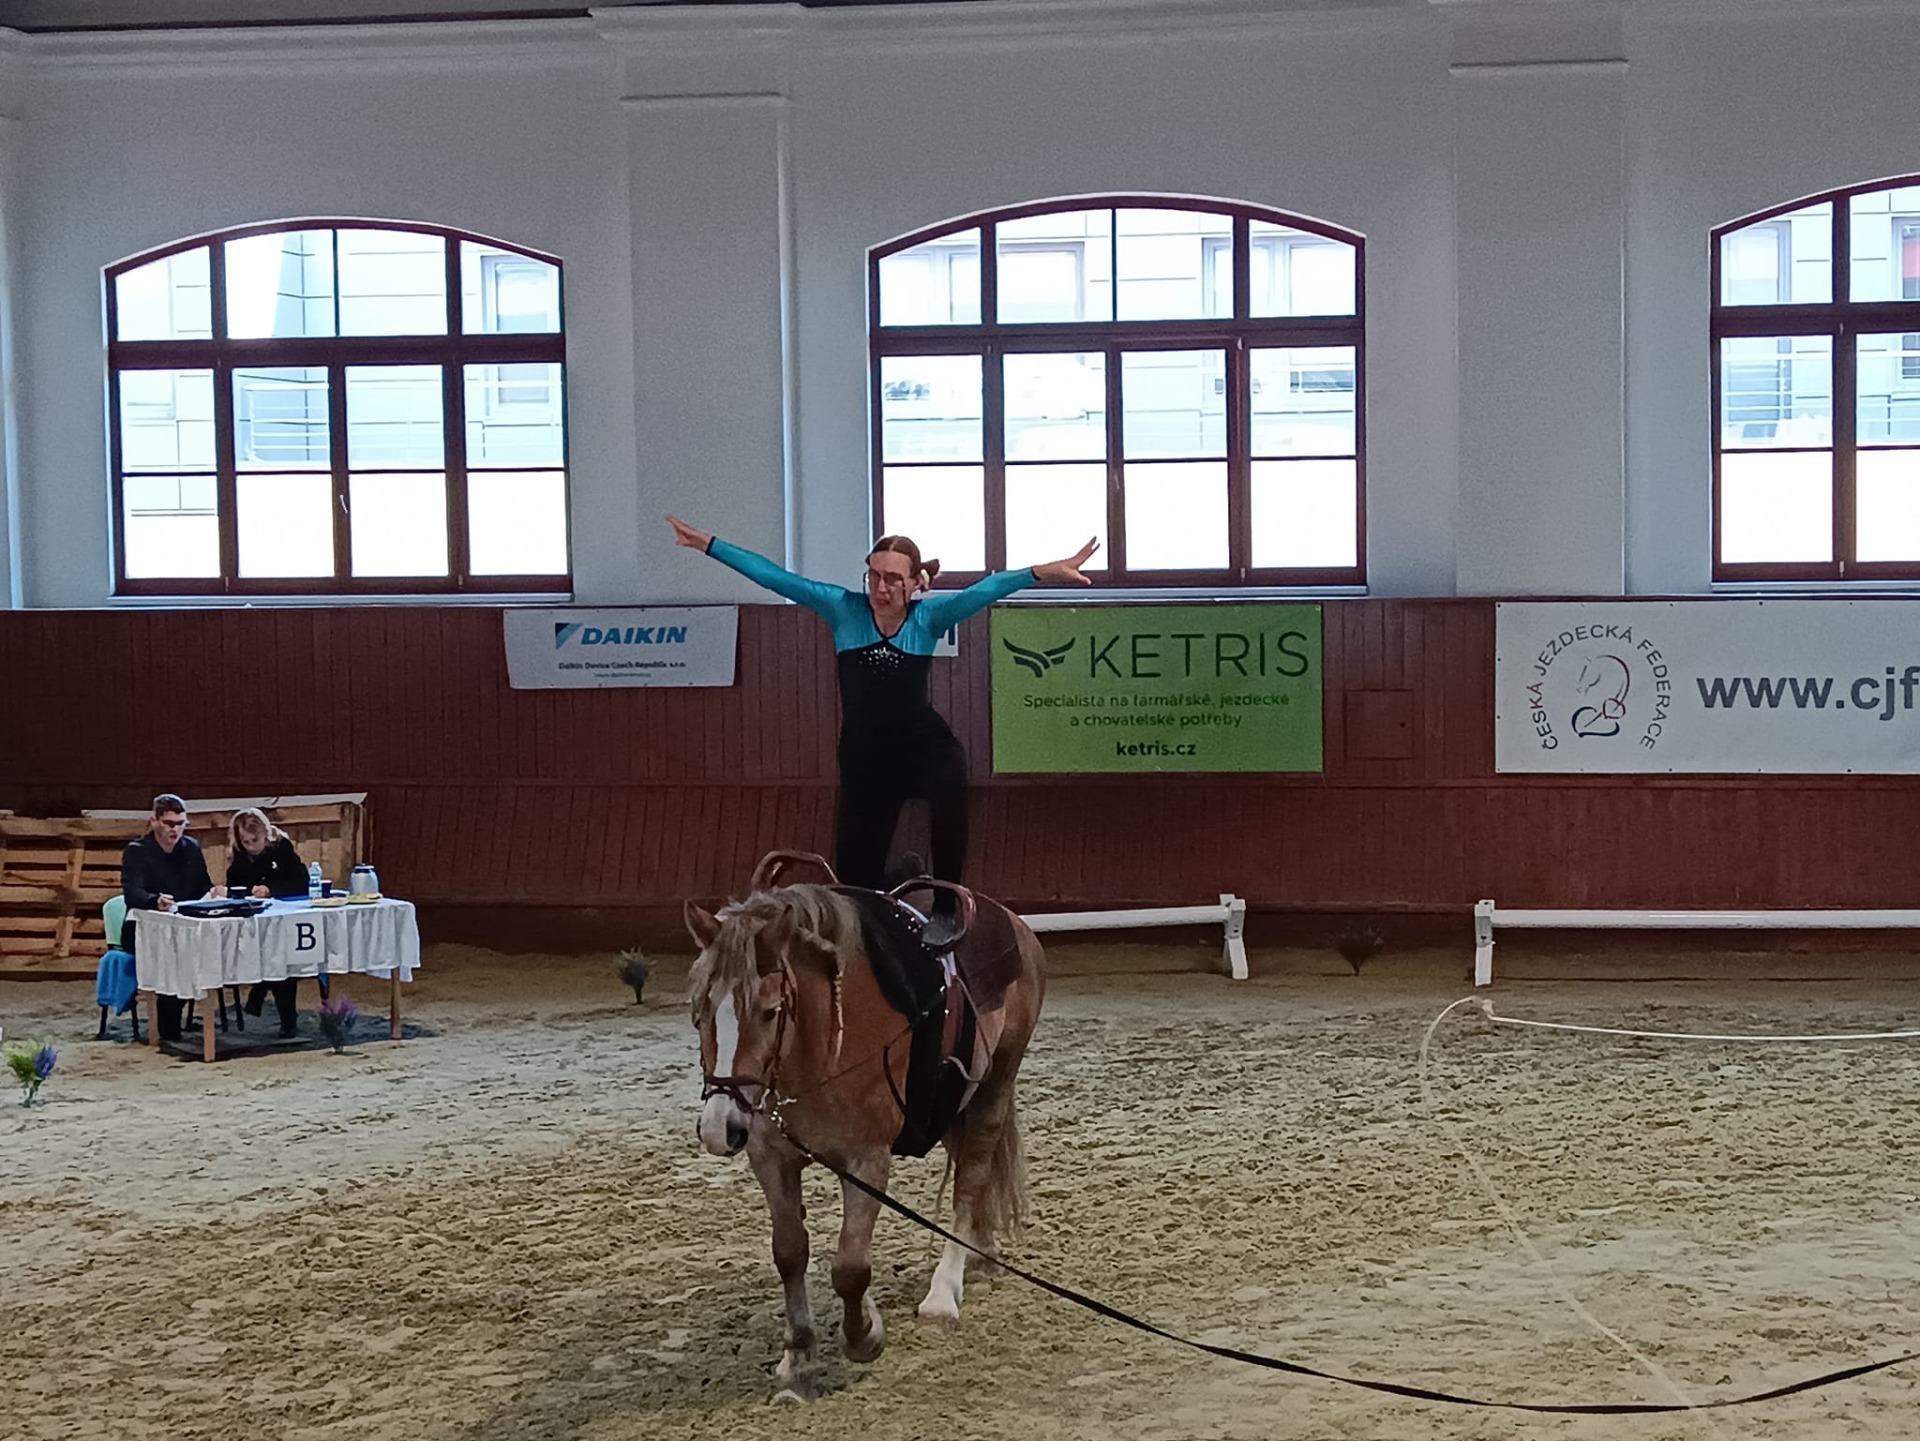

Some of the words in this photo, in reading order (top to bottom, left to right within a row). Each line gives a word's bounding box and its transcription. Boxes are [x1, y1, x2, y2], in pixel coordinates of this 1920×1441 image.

[580, 626, 687, 645] DAIKIN
[1534, 624, 1632, 676] JEZDECKÁ
[1090, 631, 1309, 678] KETRIS
[1023, 694, 1104, 709] Specialista
[1110, 696, 1128, 708] na
[1220, 691, 1290, 709] jezdecké
[1637, 639, 1671, 750] FEDERACE
[1696, 666, 1920, 721] www.cjf
[1070, 715, 1080, 727] a
[1083, 712, 1176, 727] chovatelské
[1180, 713, 1242, 729] potřeby
[1526, 682, 1558, 750] ČESKÁ
[1116, 740, 1196, 756] ketris.cz
[295, 923, 317, 951] B
